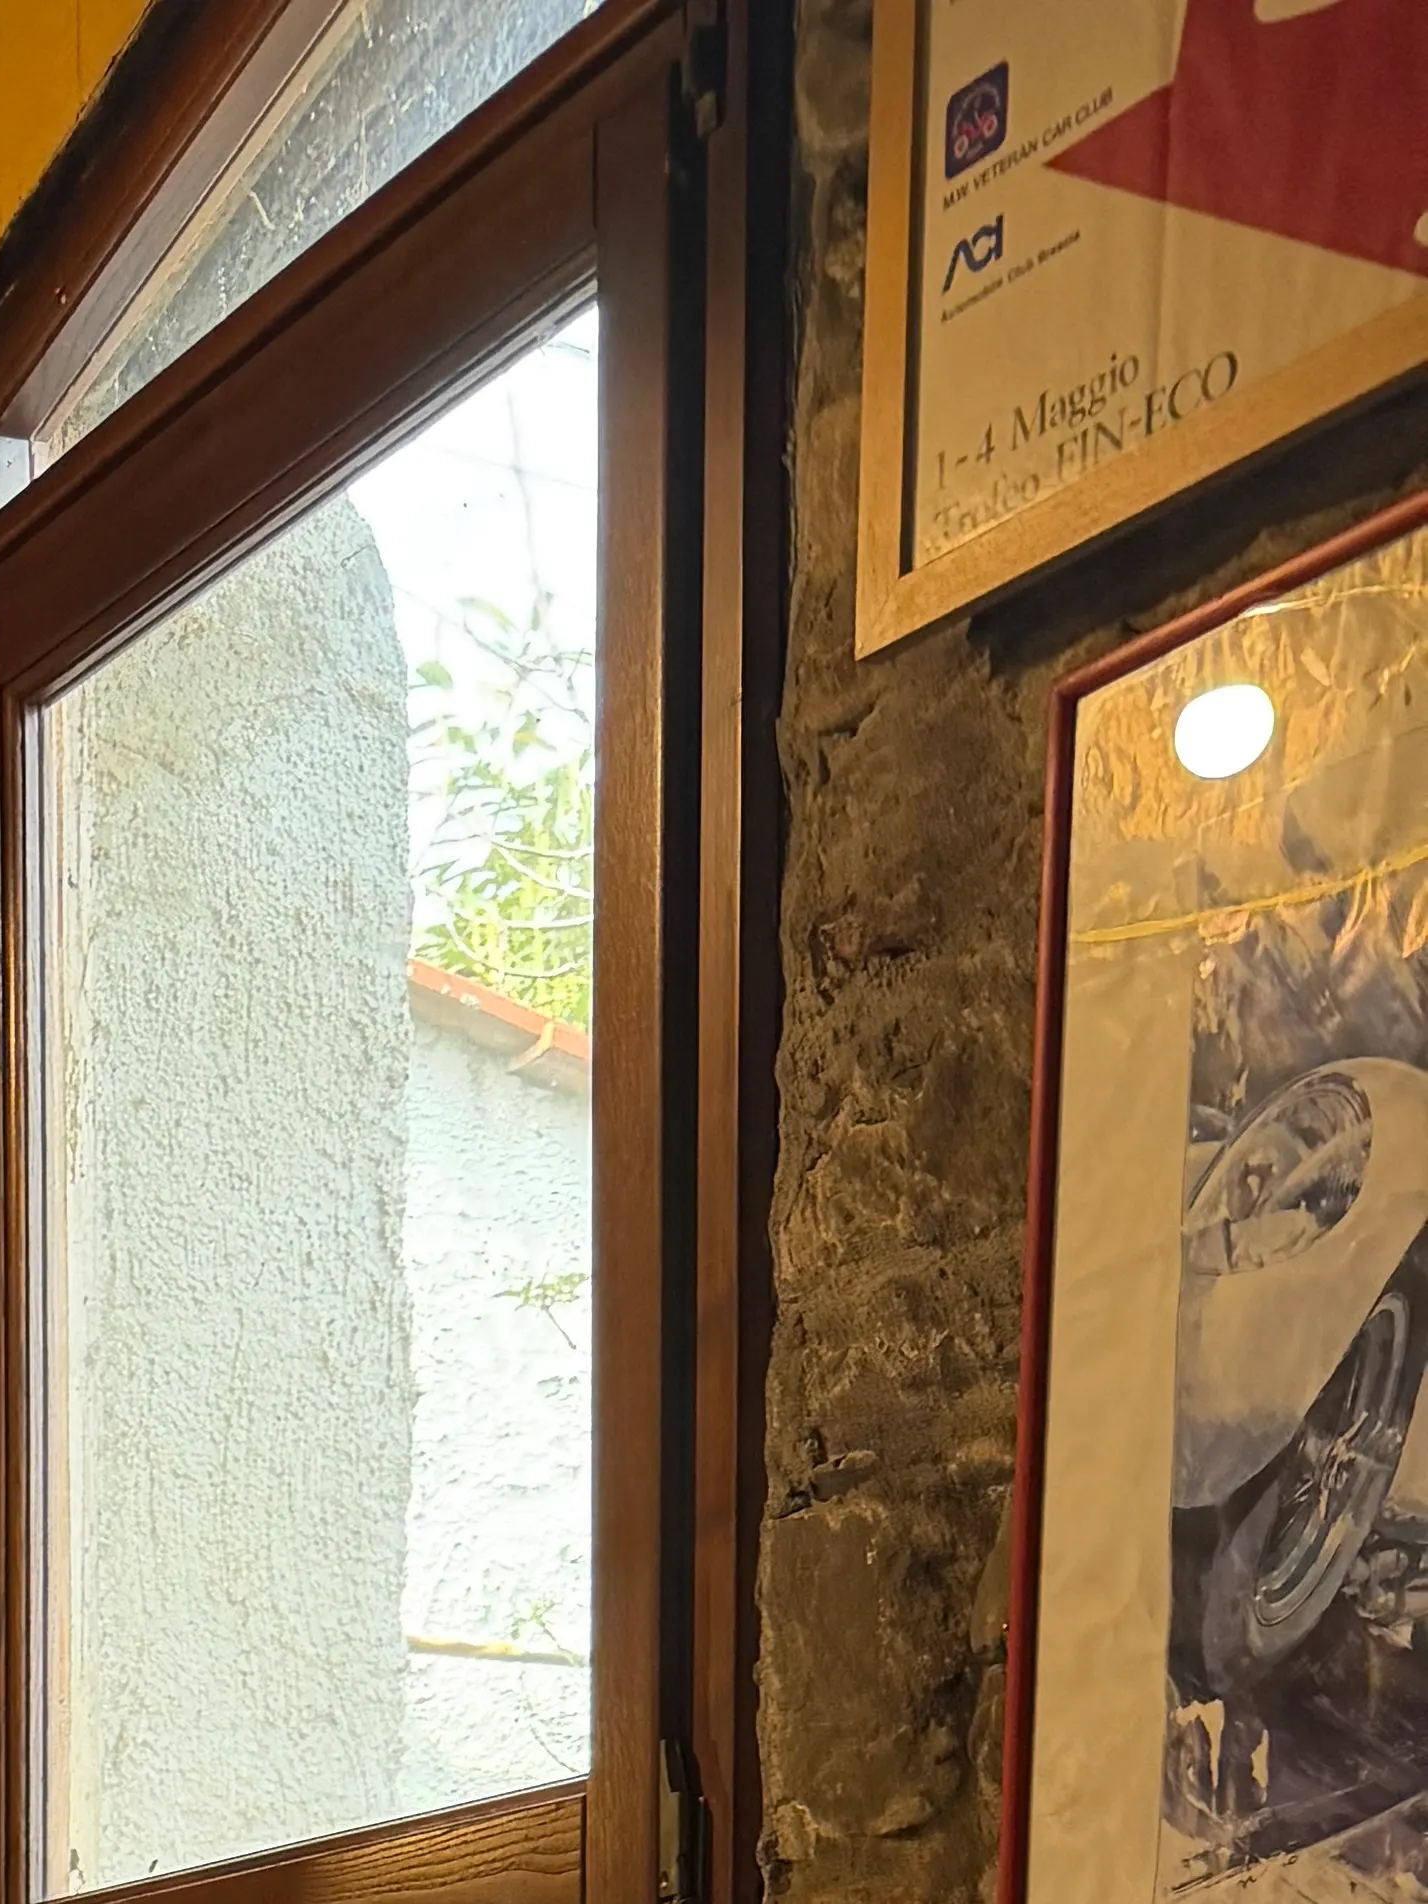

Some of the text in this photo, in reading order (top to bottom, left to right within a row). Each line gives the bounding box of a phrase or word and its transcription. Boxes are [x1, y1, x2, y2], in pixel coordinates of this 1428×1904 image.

[973, 135, 1038, 192] VETERAN
[1041, 114, 1072, 148] CAR
[1075, 84, 1114, 127] CLUB
[933, 350, 1239, 540] Trofeo FIN-ECO
[1011, 351, 1140, 452] Maggio
